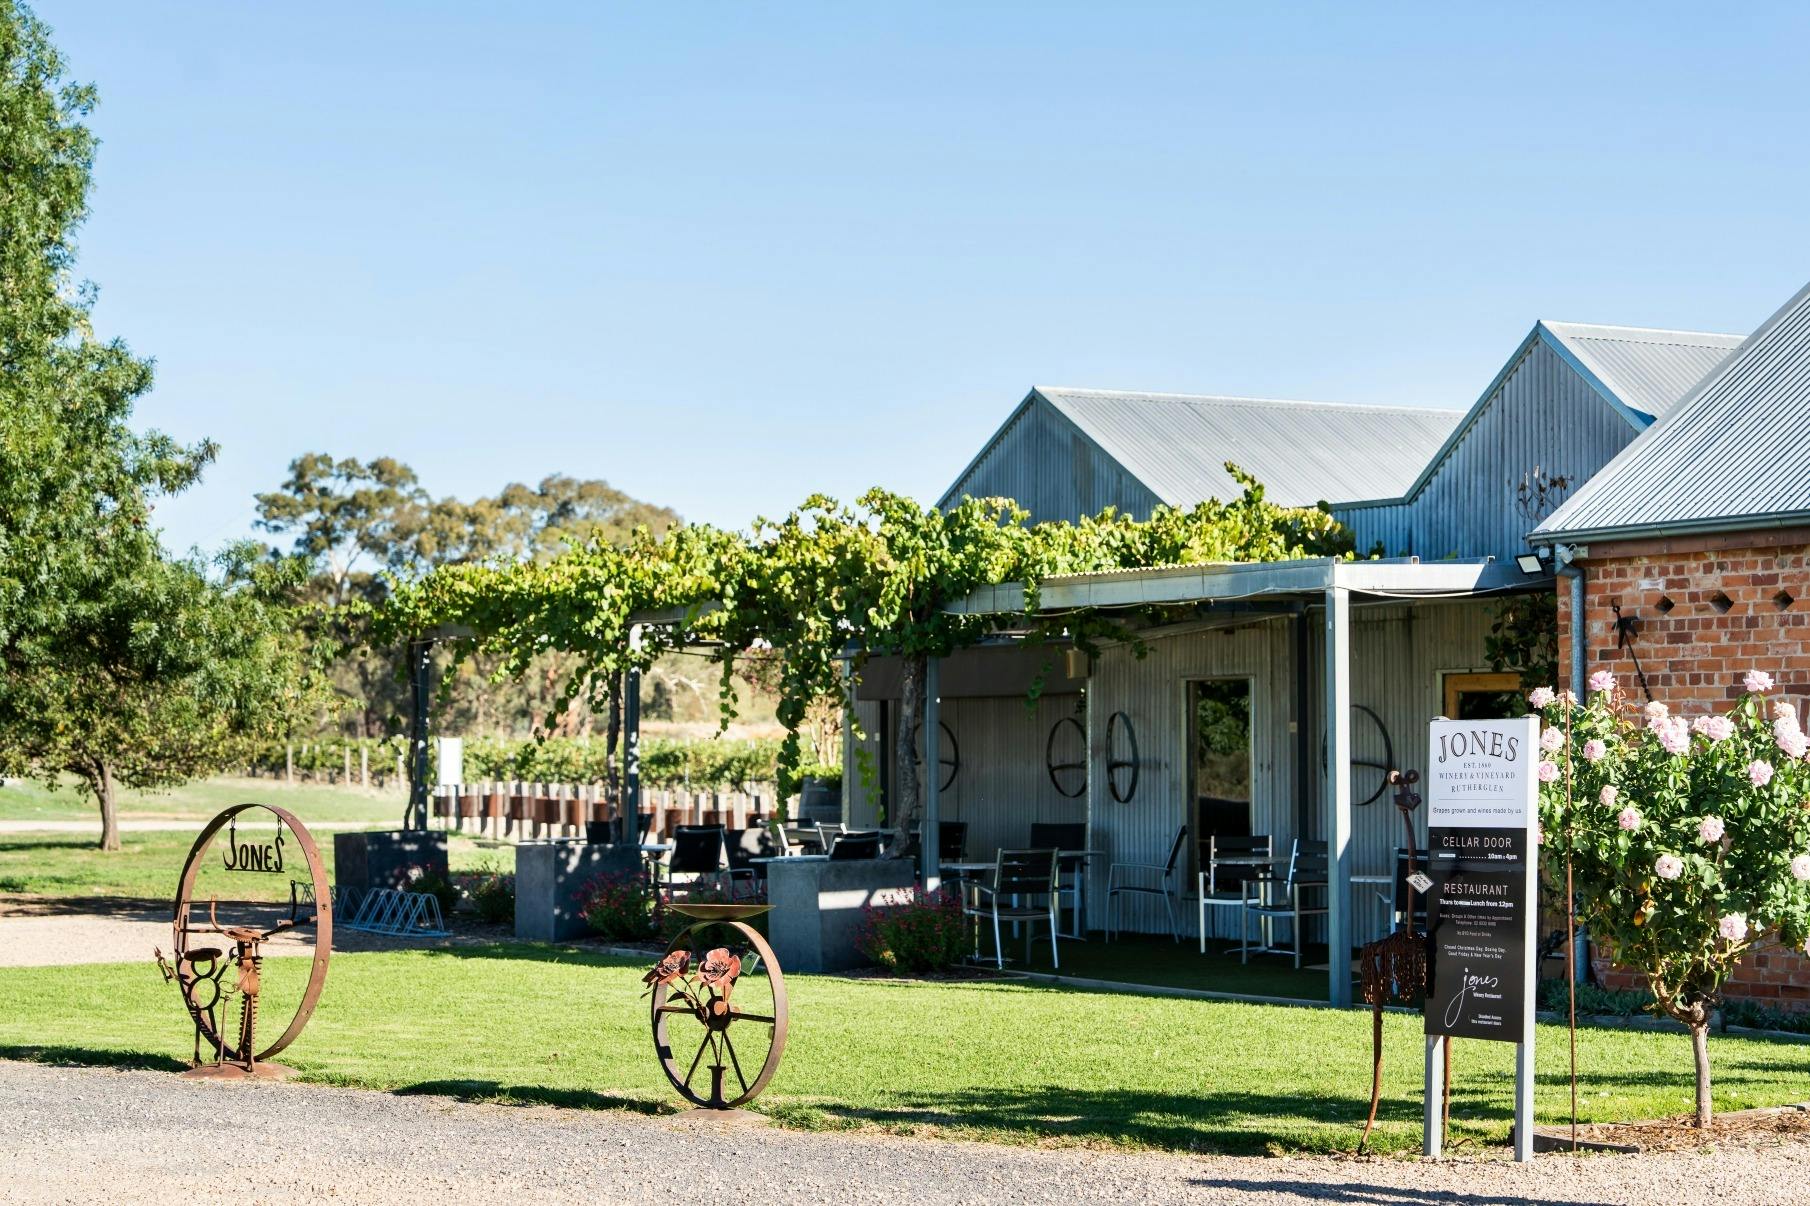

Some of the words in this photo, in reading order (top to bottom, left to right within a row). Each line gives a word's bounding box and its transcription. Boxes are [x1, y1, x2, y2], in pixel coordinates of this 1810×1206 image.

[1438, 730, 1519, 763] JONES
[1439, 772, 1467, 780] WINERY
[1476, 771, 1515, 779] VINEYARD
[1451, 783, 1504, 793] RUTHERGLEN
[1507, 807, 1514, 815] by
[1442, 836, 1480, 848] CELLAR
[1483, 837, 1512, 848] DOOR
[1506, 853, 1518, 861] 4pm
[1443, 883, 1508, 895] RESTAURANT
[1499, 901, 1514, 909] 12pm
[1444, 967, 1499, 1028] jones
